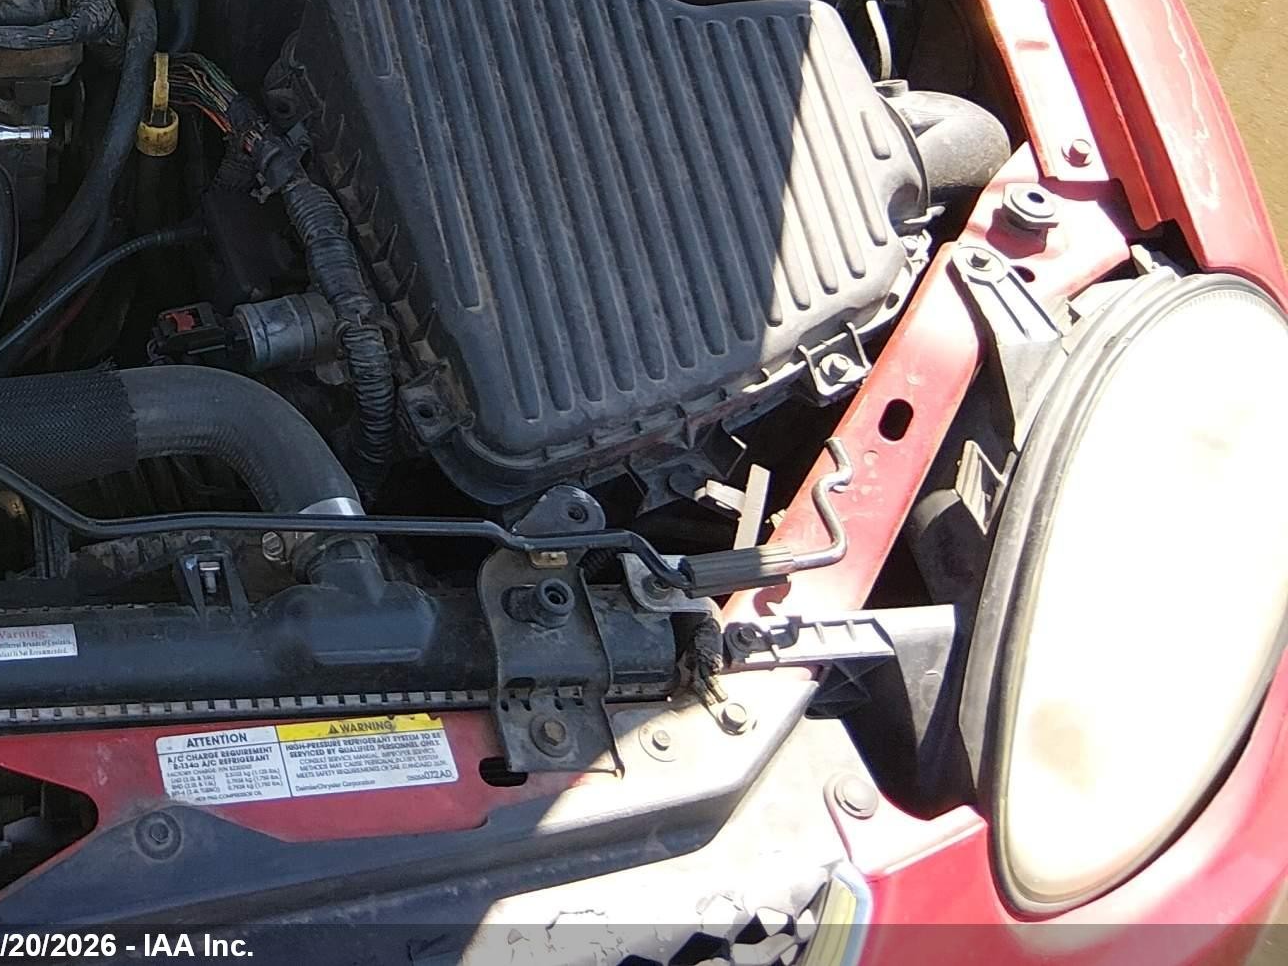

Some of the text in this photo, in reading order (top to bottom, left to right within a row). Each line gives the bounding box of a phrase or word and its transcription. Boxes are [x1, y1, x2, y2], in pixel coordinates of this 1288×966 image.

[340, 721, 393, 733] WARNING
[186, 733, 247, 748] ATTENTION
[186, 752, 218, 761] CHARGE
[221, 747, 272, 757] REQUIREMENT
[290, 749, 324, 757] SERVICED
[377, 742, 418, 750] PERSONNEL
[173, 762, 199, 770] R-134a
[219, 755, 269, 765] REFRIGERANT
